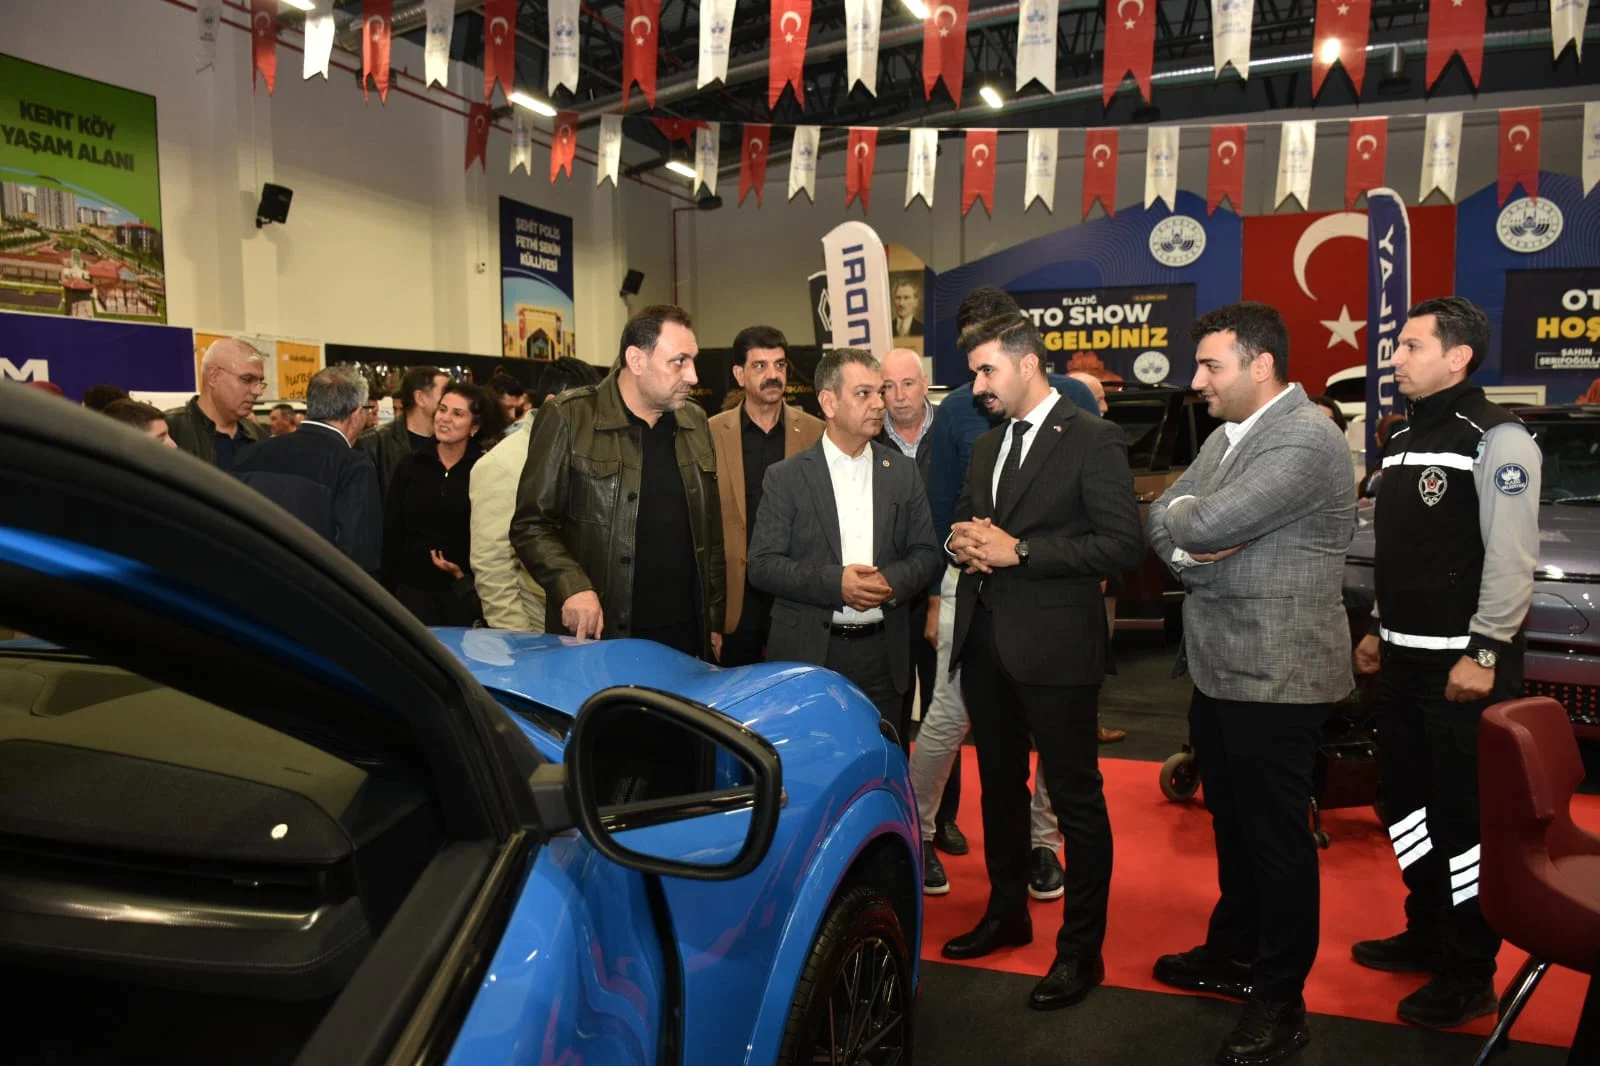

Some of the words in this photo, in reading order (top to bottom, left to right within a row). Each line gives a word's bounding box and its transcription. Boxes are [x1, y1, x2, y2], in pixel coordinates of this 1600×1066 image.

[19, 99, 74, 131] KENT
[78, 113, 116, 141] KÖY
[1, 124, 74, 158] YAŞAM
[78, 143, 135, 172] ALANI
[1062, 294, 1097, 306] ELAZIĞ
[1068, 303, 1152, 326] SHOW
[1040, 323, 1168, 351] GELDİNİZ
